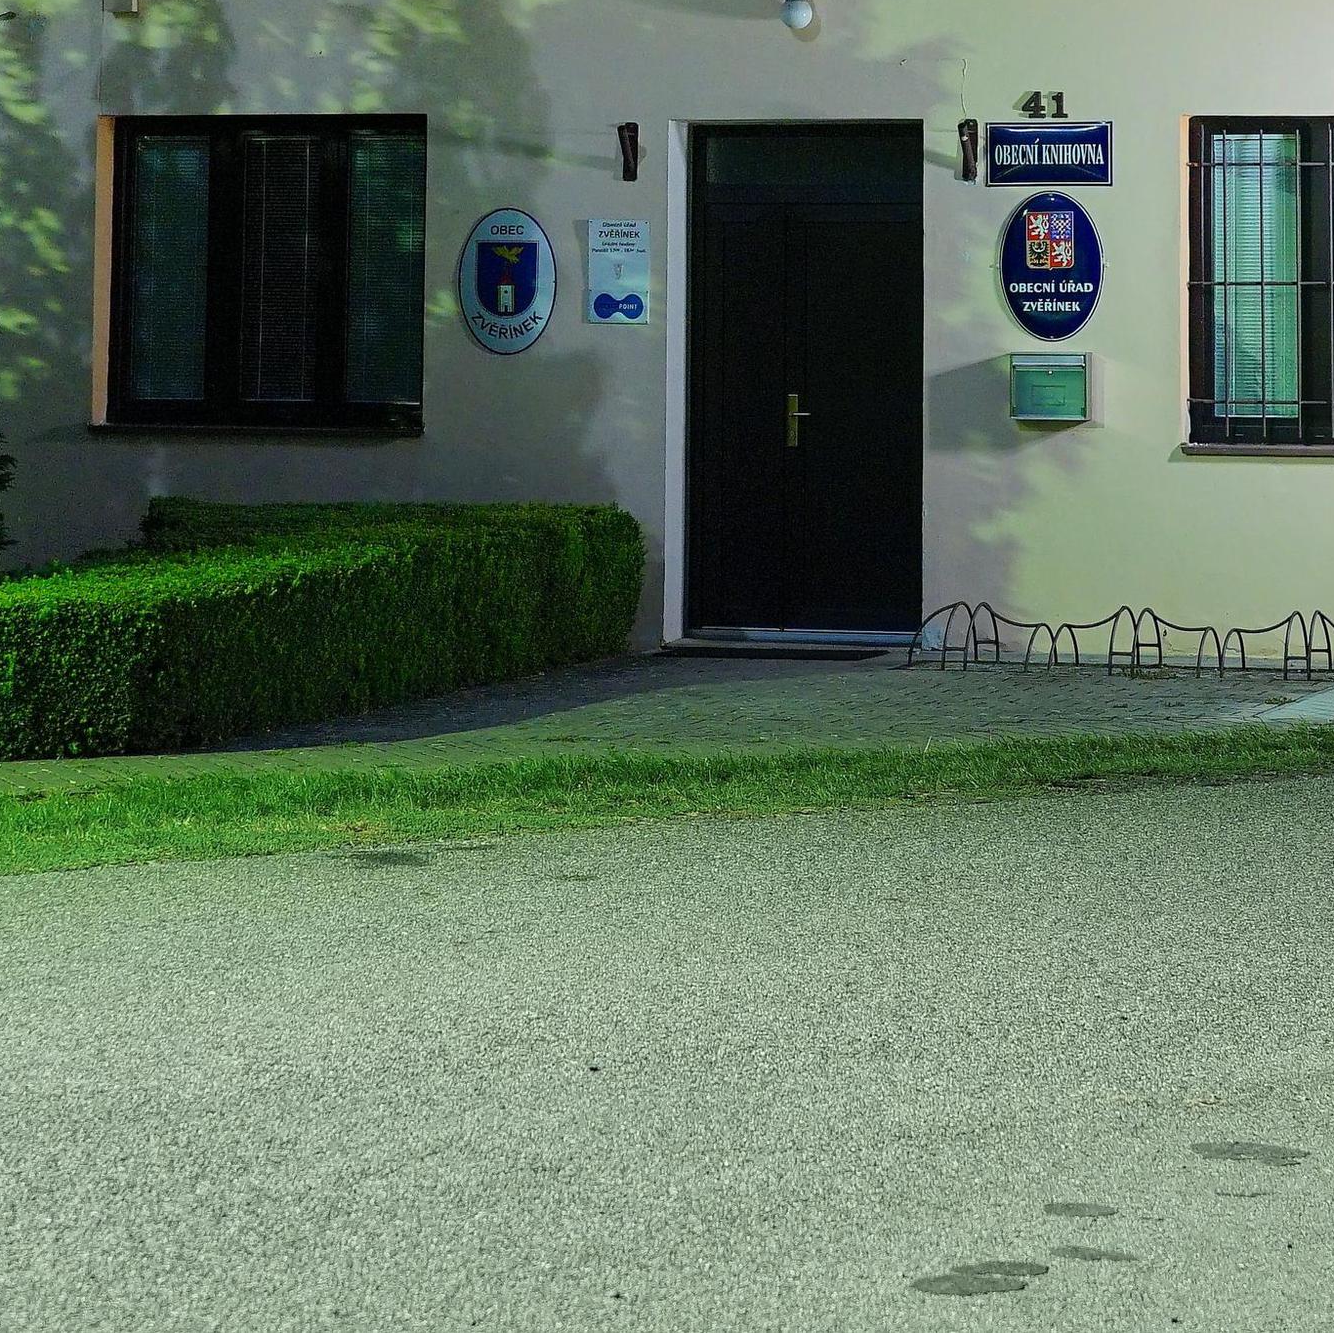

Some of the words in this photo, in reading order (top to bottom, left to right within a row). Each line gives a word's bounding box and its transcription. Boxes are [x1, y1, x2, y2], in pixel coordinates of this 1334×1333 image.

[1021, 91, 1068, 118] 41
[994, 138, 1040, 165] OBECNÍ
[1042, 144, 1104, 165] KNIHOVNA
[490, 225, 525, 235] OBEC
[598, 229, 640, 238] ZVĚŘÍNEK
[1009, 280, 1056, 293] OBECNÍ
[1059, 280, 1094, 293] ÚŘAD
[1022, 298, 1081, 312] ZVĚŘÍNEK
[471, 310, 544, 339] ZVĚŘÍNEK
